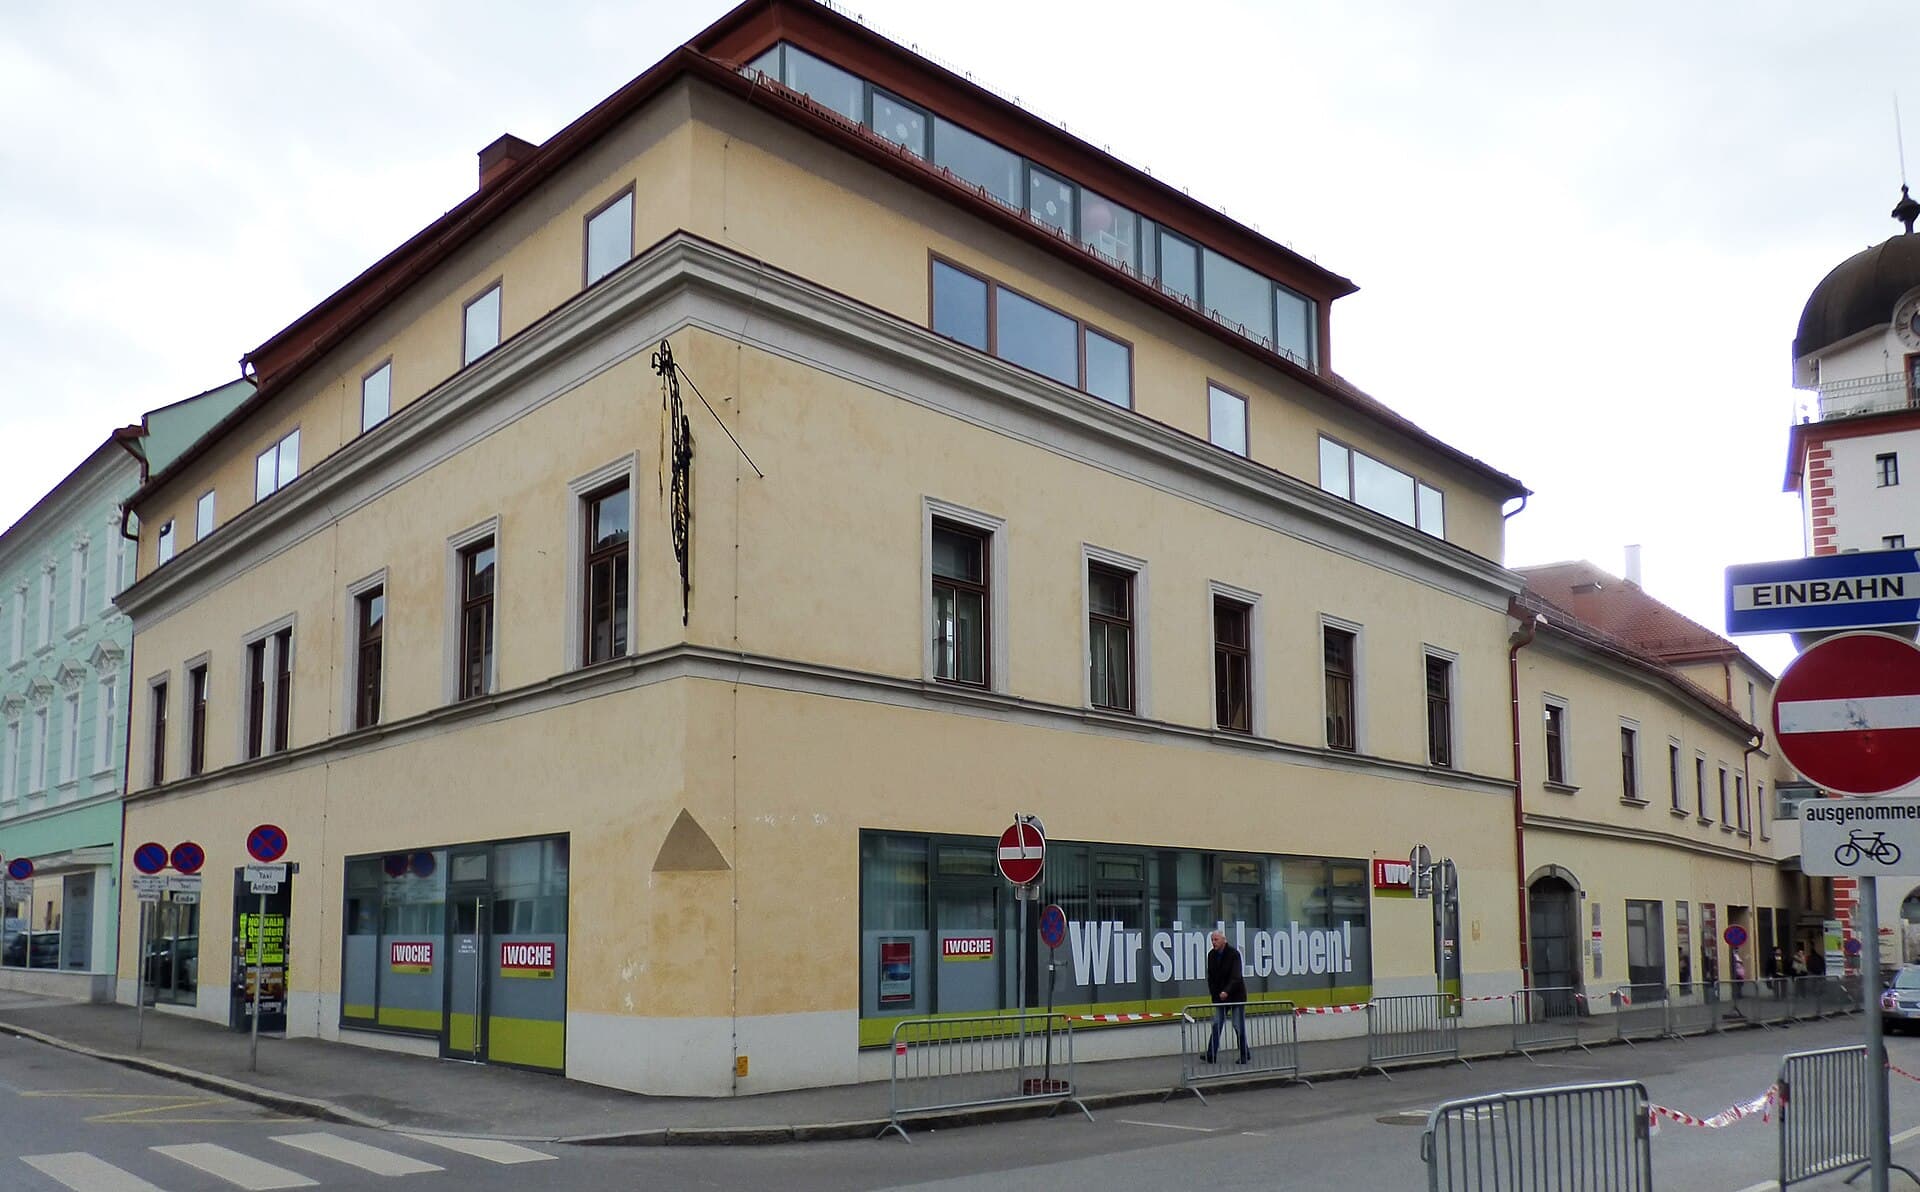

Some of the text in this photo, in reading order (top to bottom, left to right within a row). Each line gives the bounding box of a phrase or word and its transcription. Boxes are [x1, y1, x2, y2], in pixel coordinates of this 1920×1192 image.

[1753, 576, 1904, 606] EINBAHN
[396, 944, 431, 963] WOCHE
[507, 945, 552, 966] WOCHE
[949, 939, 991, 953] WOCHE
[1069, 921, 1142, 986] Wir
[1236, 921, 1352, 978] Leoben!
